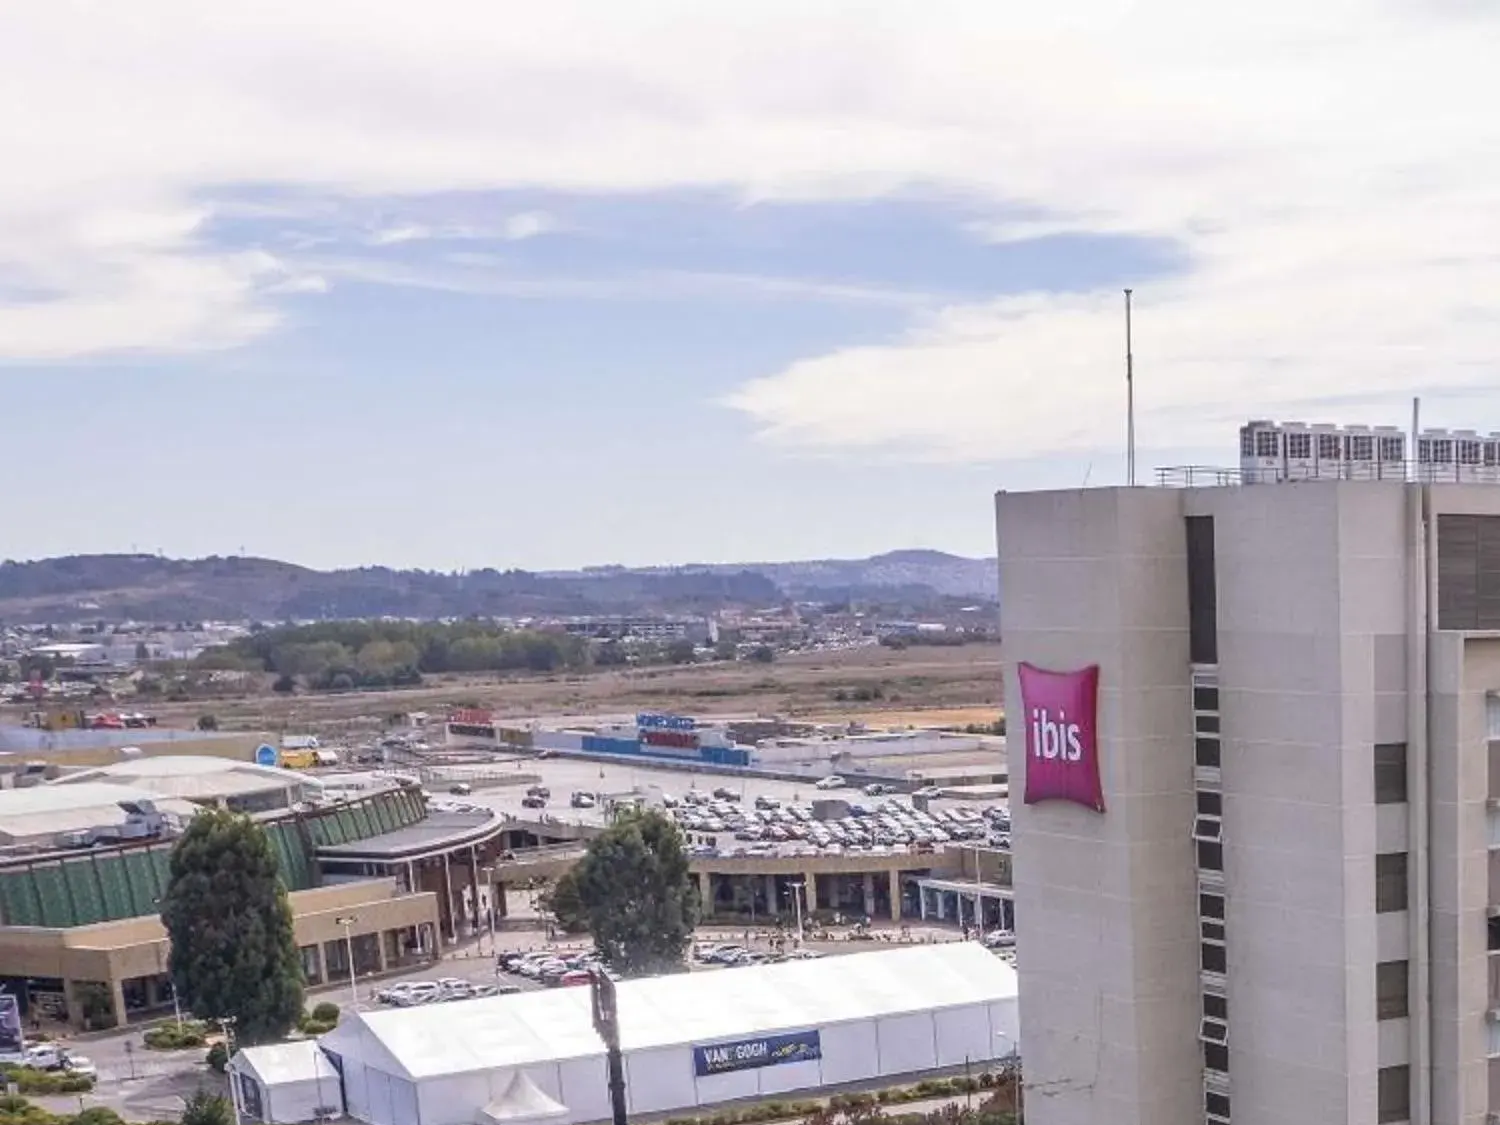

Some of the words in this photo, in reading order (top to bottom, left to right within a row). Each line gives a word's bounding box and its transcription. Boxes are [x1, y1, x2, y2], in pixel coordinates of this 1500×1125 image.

[1033, 708, 1081, 761] ibis
[703, 1046, 729, 1065] VAN
[735, 1041, 767, 1059] GOGH
